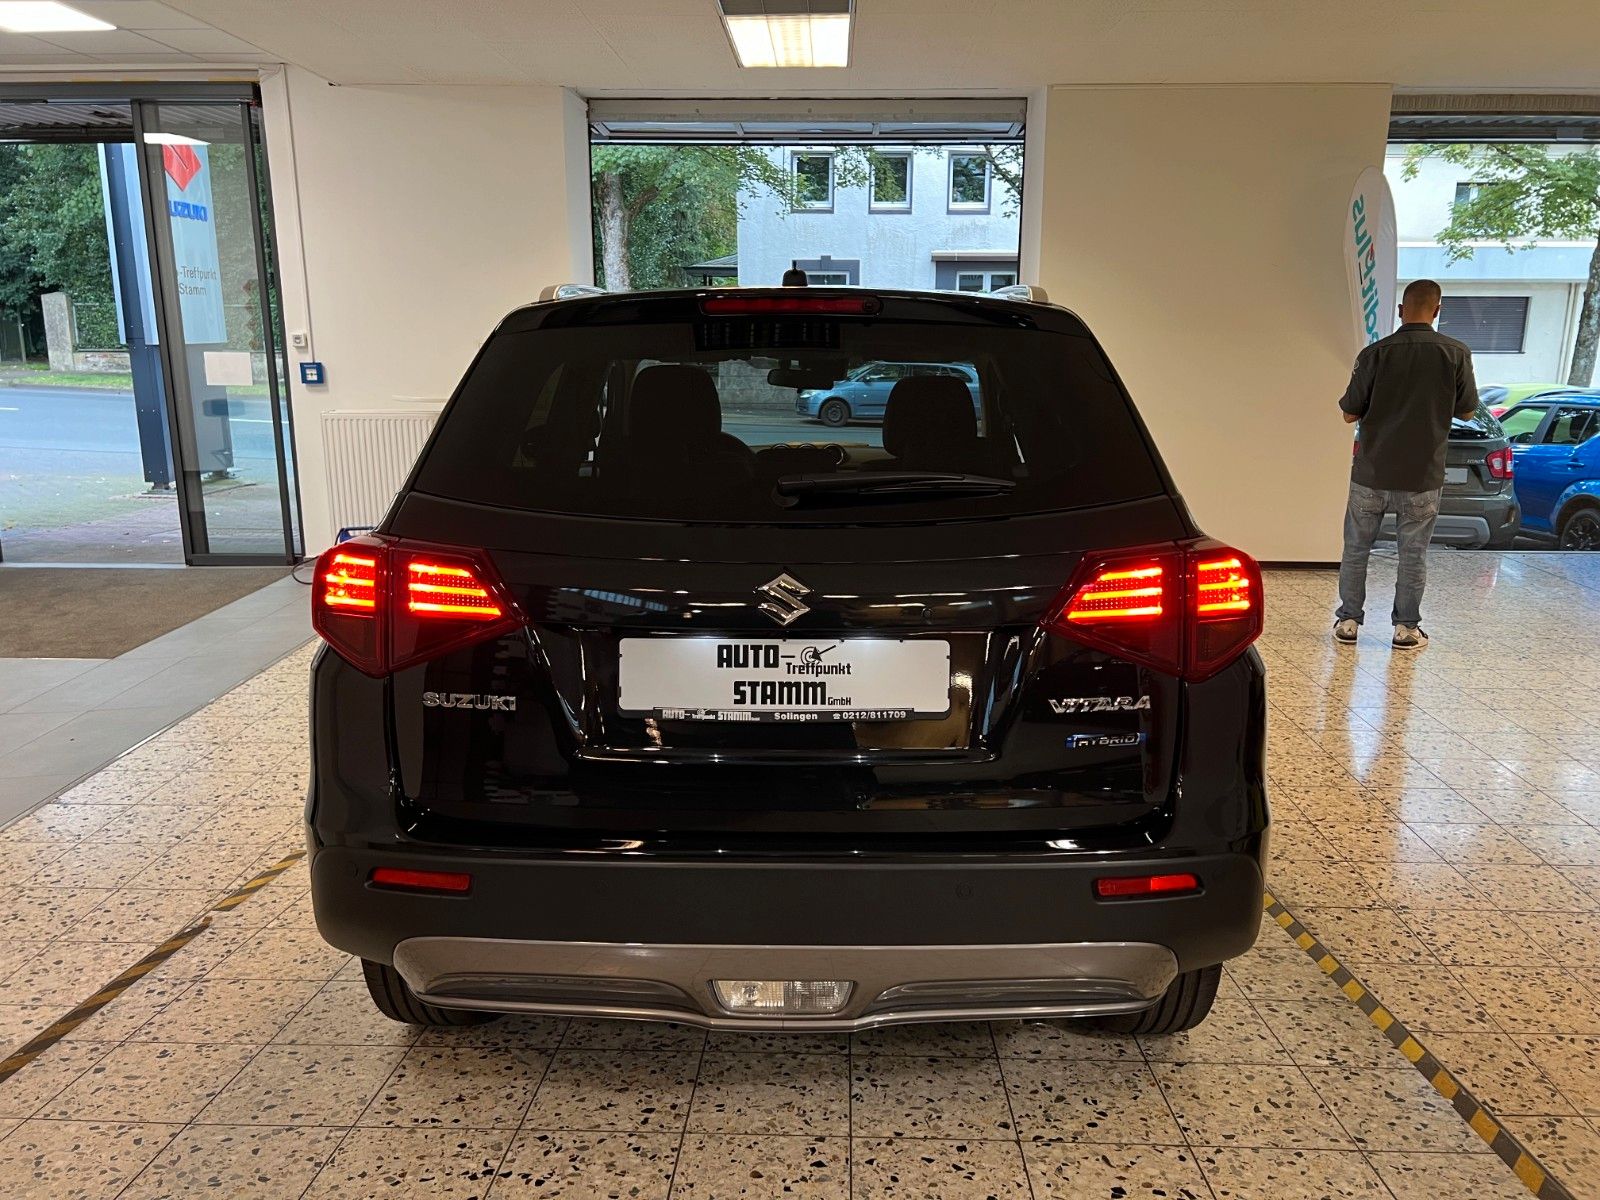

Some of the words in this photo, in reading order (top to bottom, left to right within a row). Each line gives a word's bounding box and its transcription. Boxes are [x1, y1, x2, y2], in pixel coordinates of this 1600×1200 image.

[169, 200, 208, 222] UZUKI
[786, 662, 852, 677] Treffpunkt
[422, 691, 517, 711] SUZUKI
[827, 696, 852, 706] GmbH
[1048, 695, 1151, 714] VITARA
[774, 712, 818, 721] Solingen
[842, 710, 907, 720] 0212/811709
[1078, 735, 1136, 747] HYBRID
